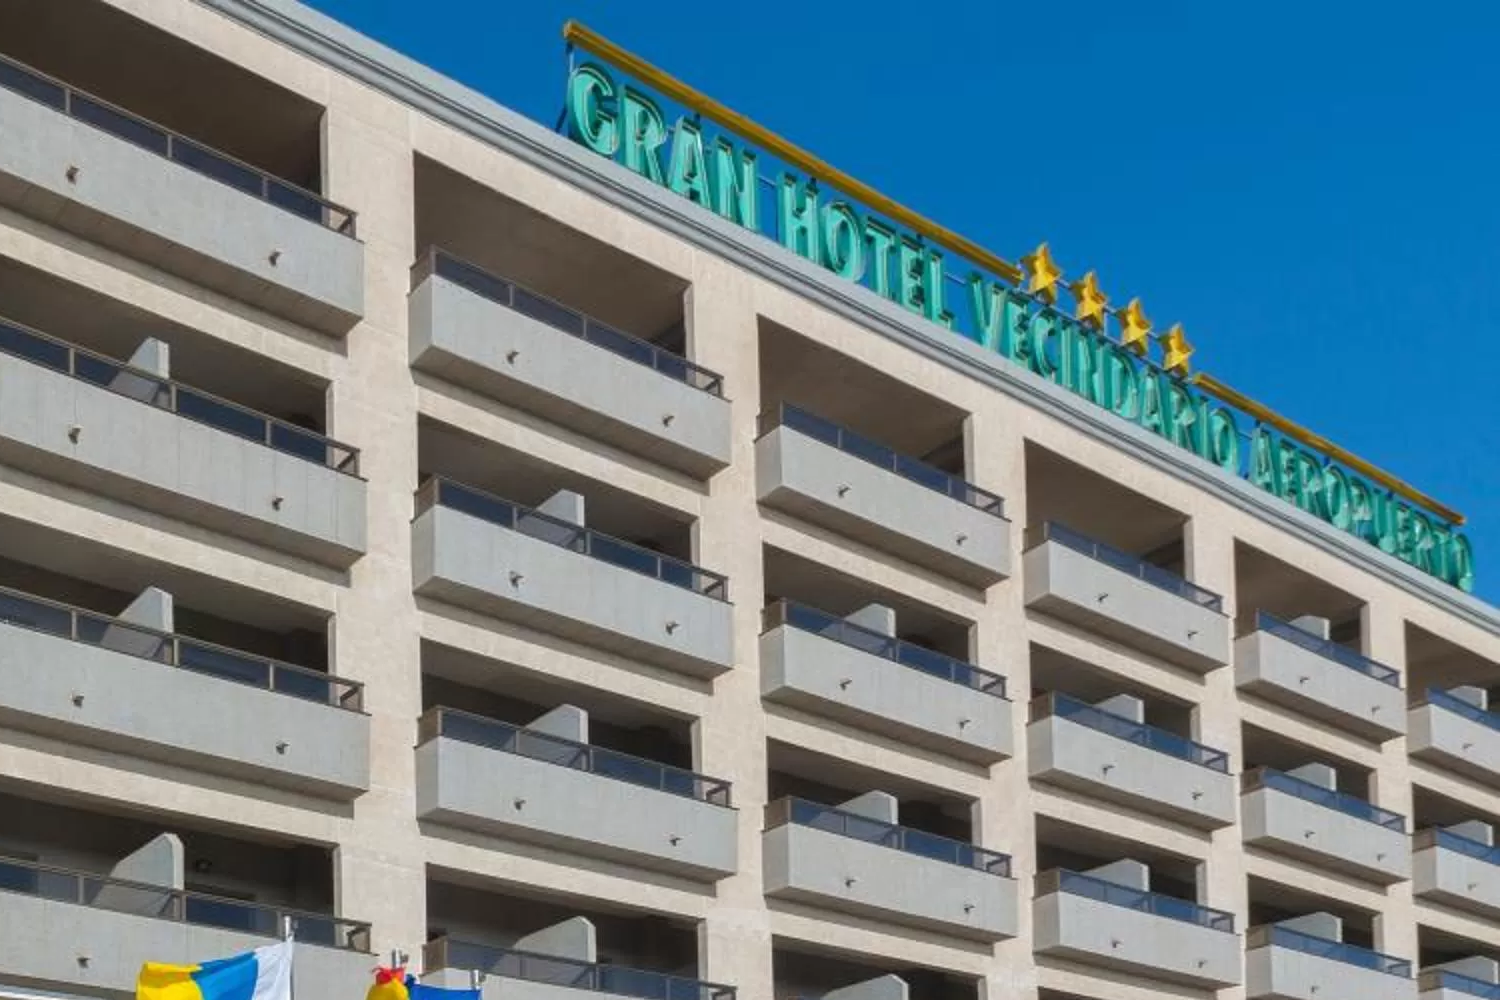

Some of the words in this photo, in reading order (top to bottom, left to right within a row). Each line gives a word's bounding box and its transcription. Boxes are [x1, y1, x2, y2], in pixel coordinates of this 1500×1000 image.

[568, 61, 760, 231] GRAN
[777, 173, 955, 330] HOTEL
[969, 271, 1240, 474] VECINDARIO
[1252, 427, 1473, 592] AEROPUERTO
